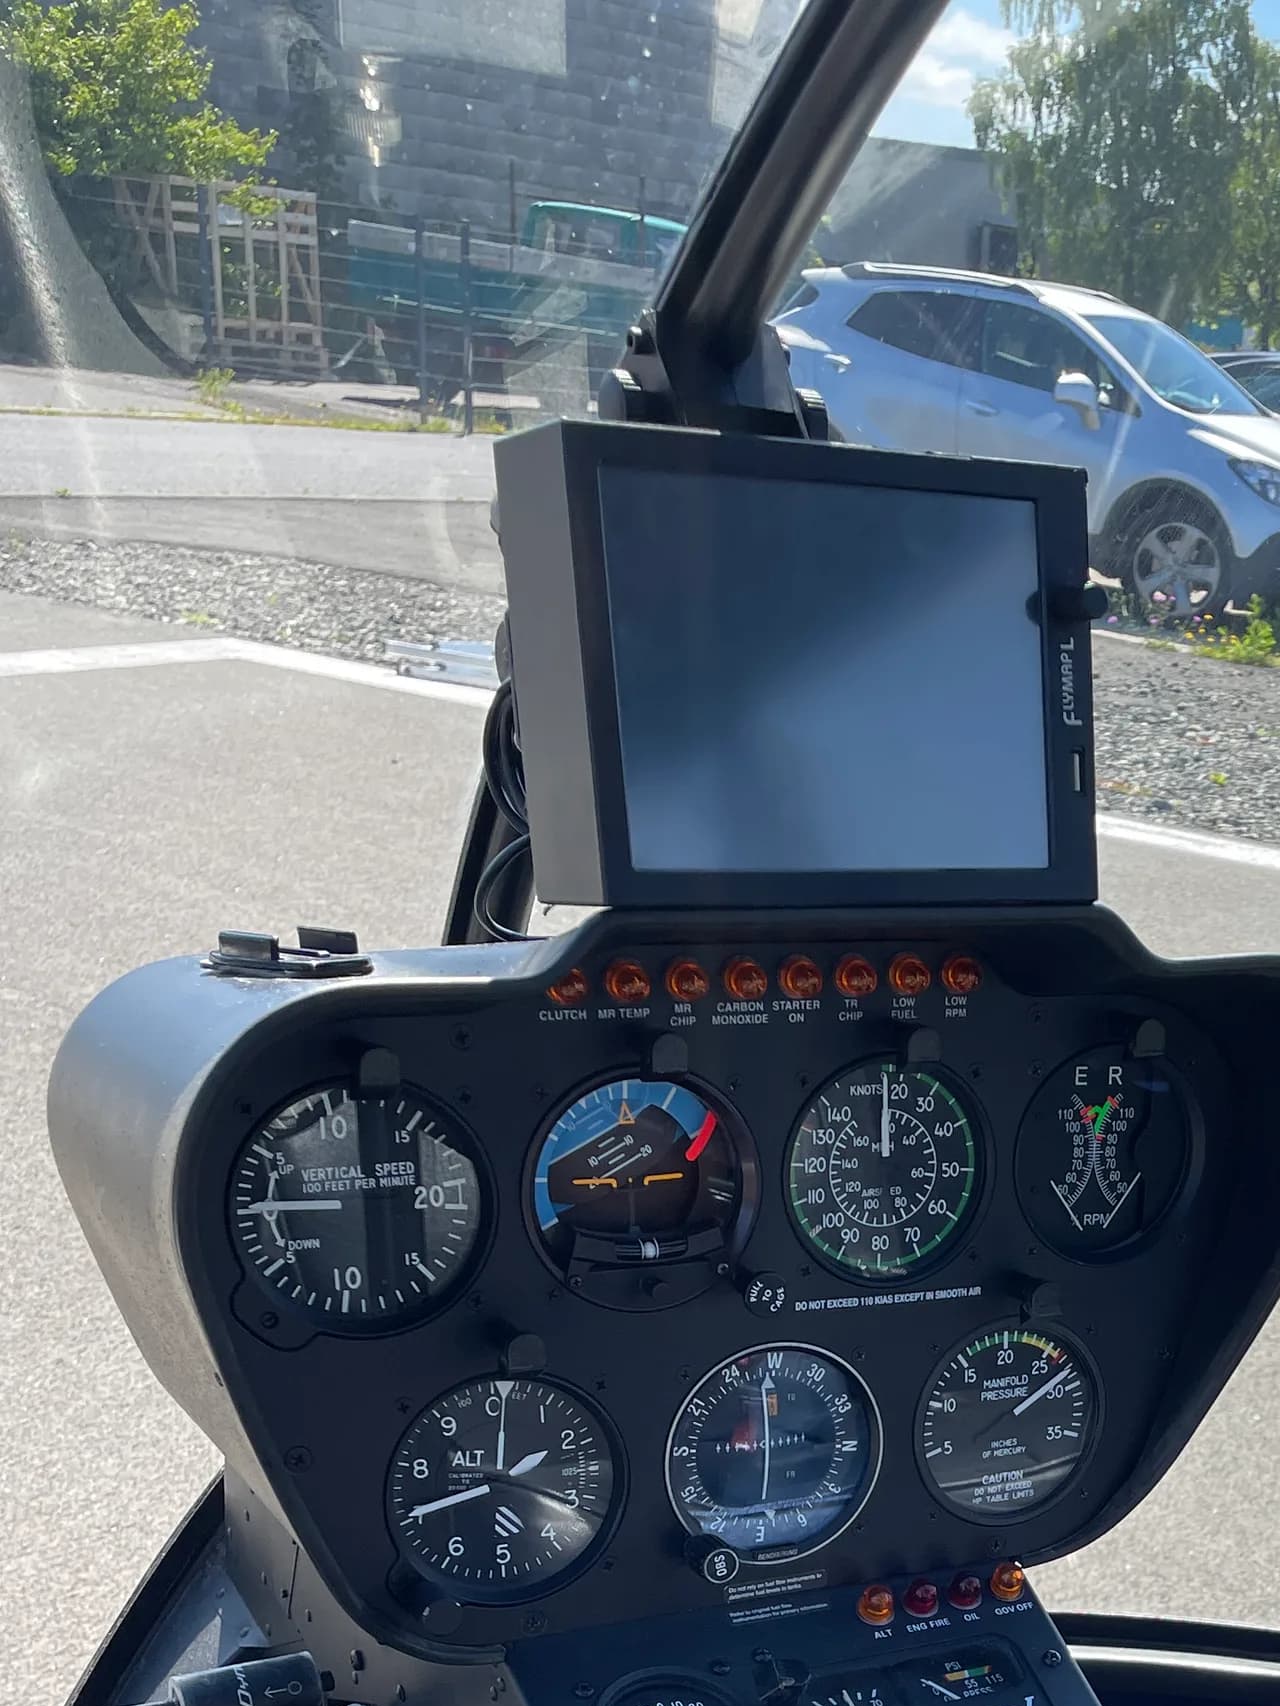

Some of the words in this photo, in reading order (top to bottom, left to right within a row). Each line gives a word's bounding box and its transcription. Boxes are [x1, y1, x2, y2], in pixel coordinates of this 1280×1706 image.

[1060, 651, 1083, 727] FLYMAP
[717, 1002, 764, 1012] CARBON
[773, 1000, 820, 1011] STARTER
[844, 999, 858, 1009] TR
[893, 998, 915, 1008] LOW
[945, 996, 967, 1006] LOW
[539, 1010, 587, 1021] CLUTCH
[598, 1009, 616, 1019] MR
[618, 1008, 650, 1018] TEMP
[675, 1004, 691, 1013] MR
[892, 1010, 917, 1019] FUEL
[946, 1008, 966, 1018] RPM
[670, 1016, 696, 1027] CHIP
[712, 1014, 768, 1025] MONOXIDE
[789, 1013, 804, 1023] ON
[839, 1011, 863, 1021] CHIP
[1075, 1066, 1088, 1086] E
[1108, 1066, 1123, 1086] R
[850, 1085, 883, 1097] KNOTS
[827, 1106, 851, 1122] 140
[319, 1116, 347, 1140] 10
[812, 1129, 835, 1144] 130
[279, 1164, 294, 1175] UP
[301, 1165, 365, 1183] VERTICAL
[375, 1161, 415, 1177] SPEED
[804, 1157, 826, 1173] 120
[302, 1180, 322, 1193] 100
[325, 1178, 352, 1192] FEET
[355, 1177, 377, 1190] PER
[379, 1175, 416, 1187] MINUTE
[414, 1185, 445, 1210] 20
[808, 1190, 825, 1204] 110
[822, 1213, 844, 1229] 100
[1083, 1214, 1110, 1225] RPM
[288, 1238, 321, 1251] DOWN
[333, 1267, 361, 1290] 10
[750, 1281, 764, 1302] PULL
[762, 1289, 772, 1302] TO
[770, 1287, 785, 1312] CAGE
[795, 1301, 806, 1311] DO
[809, 1300, 825, 1310] NOT
[826, 1298, 859, 1309] EXCEED
[860, 1297, 873, 1306] 110
[875, 1295, 893, 1305] KIAS
[894, 1292, 924, 1303] EXCEPT
[926, 1291, 934, 1300] IN
[935, 1289, 967, 1299] SMOOTH
[968, 1287, 981, 1297] AIR
[767, 1352, 784, 1369] W
[983, 1374, 1029, 1389] MANIFOLD
[981, 1387, 1029, 1401] PRESSURE
[991, 1438, 1018, 1448] INCHES
[452, 1450, 485, 1467] ALT
[982, 1450, 992, 1459] OF
[993, 1447, 1026, 1458] MERCURY
[982, 1469, 1024, 1485] CAUTION
[974, 1488, 985, 1496] DO
[988, 1485, 1003, 1494] NOT
[1005, 1480, 1032, 1490] EXCEED
[714, 1553, 728, 1578] OBS
[994, 1605, 1016, 1616] GOV
[1016, 1601, 1034, 1612] OFF
[963, 1613, 981, 1622] OIL
[906, 1622, 928, 1634] ENG
[929, 1618, 951, 1630] FIRE
[874, 1628, 893, 1640] ALT
